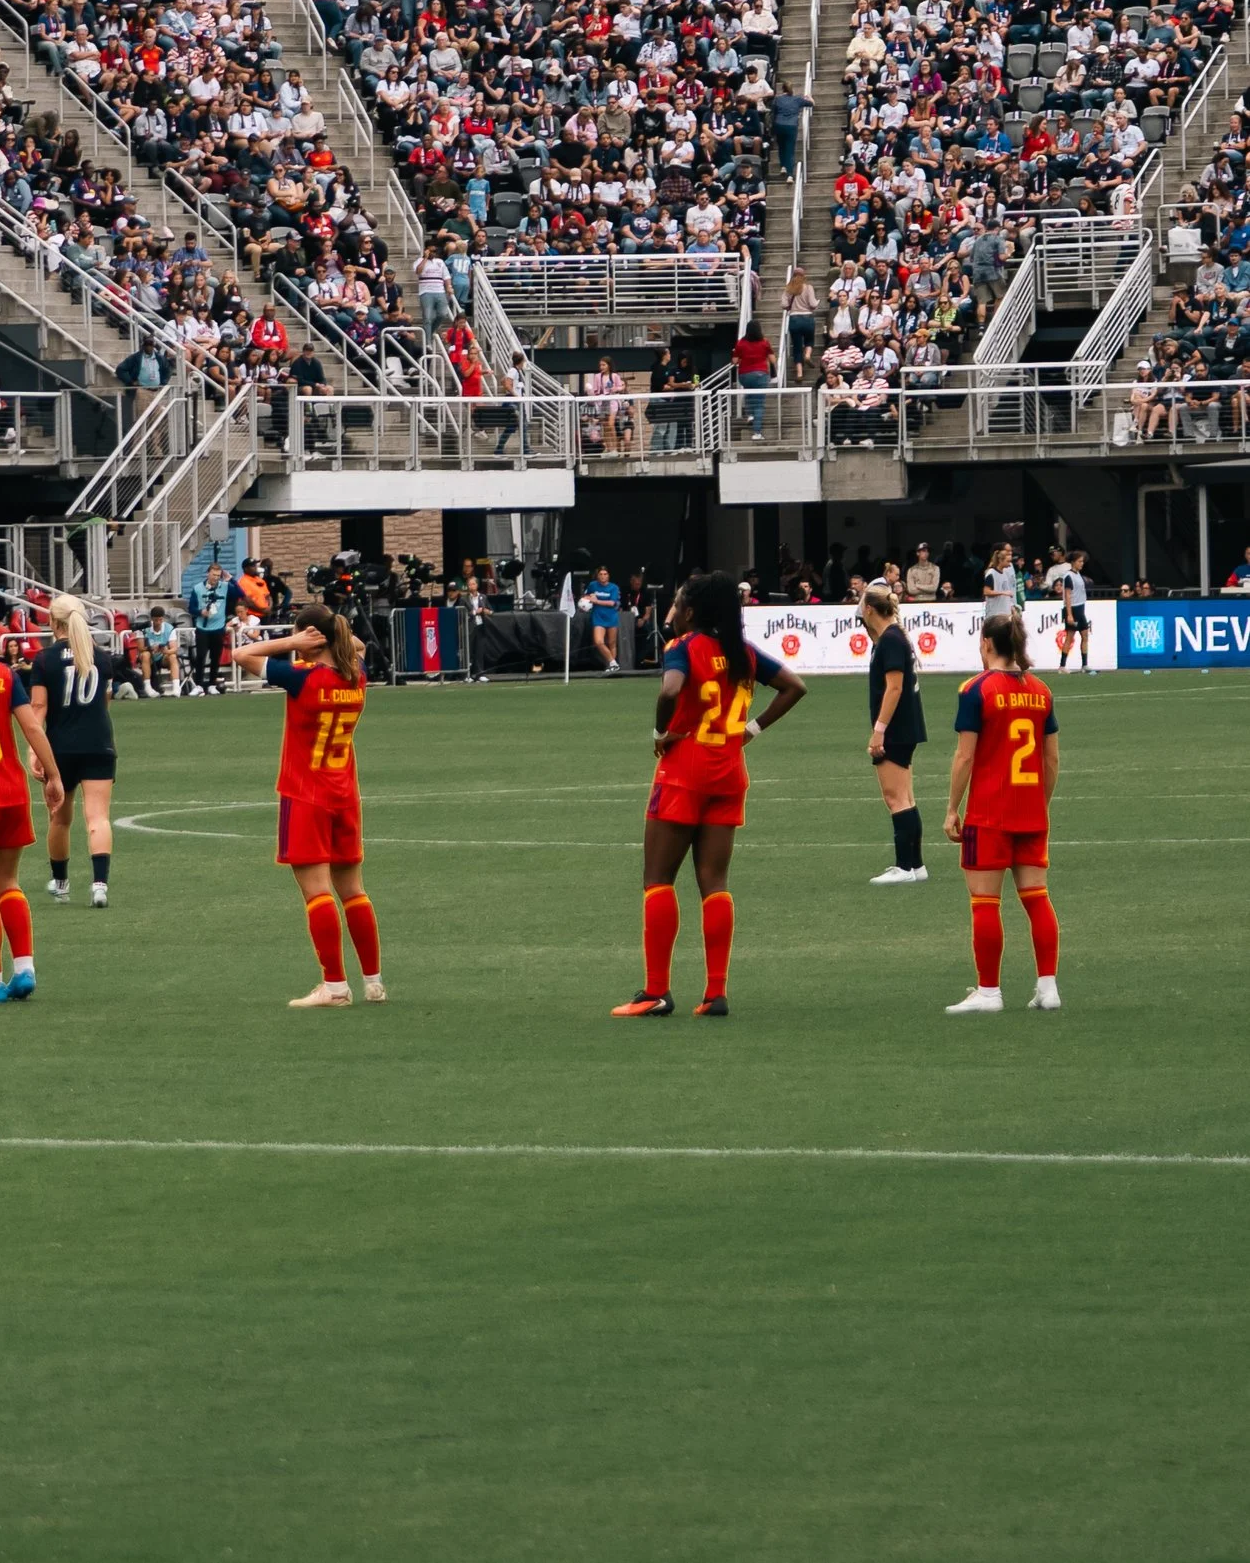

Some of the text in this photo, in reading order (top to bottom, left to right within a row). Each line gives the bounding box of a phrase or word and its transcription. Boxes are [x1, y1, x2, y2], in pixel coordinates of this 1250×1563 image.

[764, 613, 818, 639] JIM BEAM
[831, 617, 853, 638] JIM
[923, 611, 954, 635] BEAM
[1037, 613, 1059, 635] JIM
[1132, 629, 1161, 639] YORK
[1134, 619, 1159, 630] NEW
[1134, 638, 1159, 649] LIFE
[63, 665, 99, 706] 10
[320, 688, 364, 704] L. CODINA
[1009, 693, 1046, 709] BATLLE
[696, 680, 753, 745] 24
[311, 711, 359, 768] 15
[1010, 718, 1038, 784] 2
